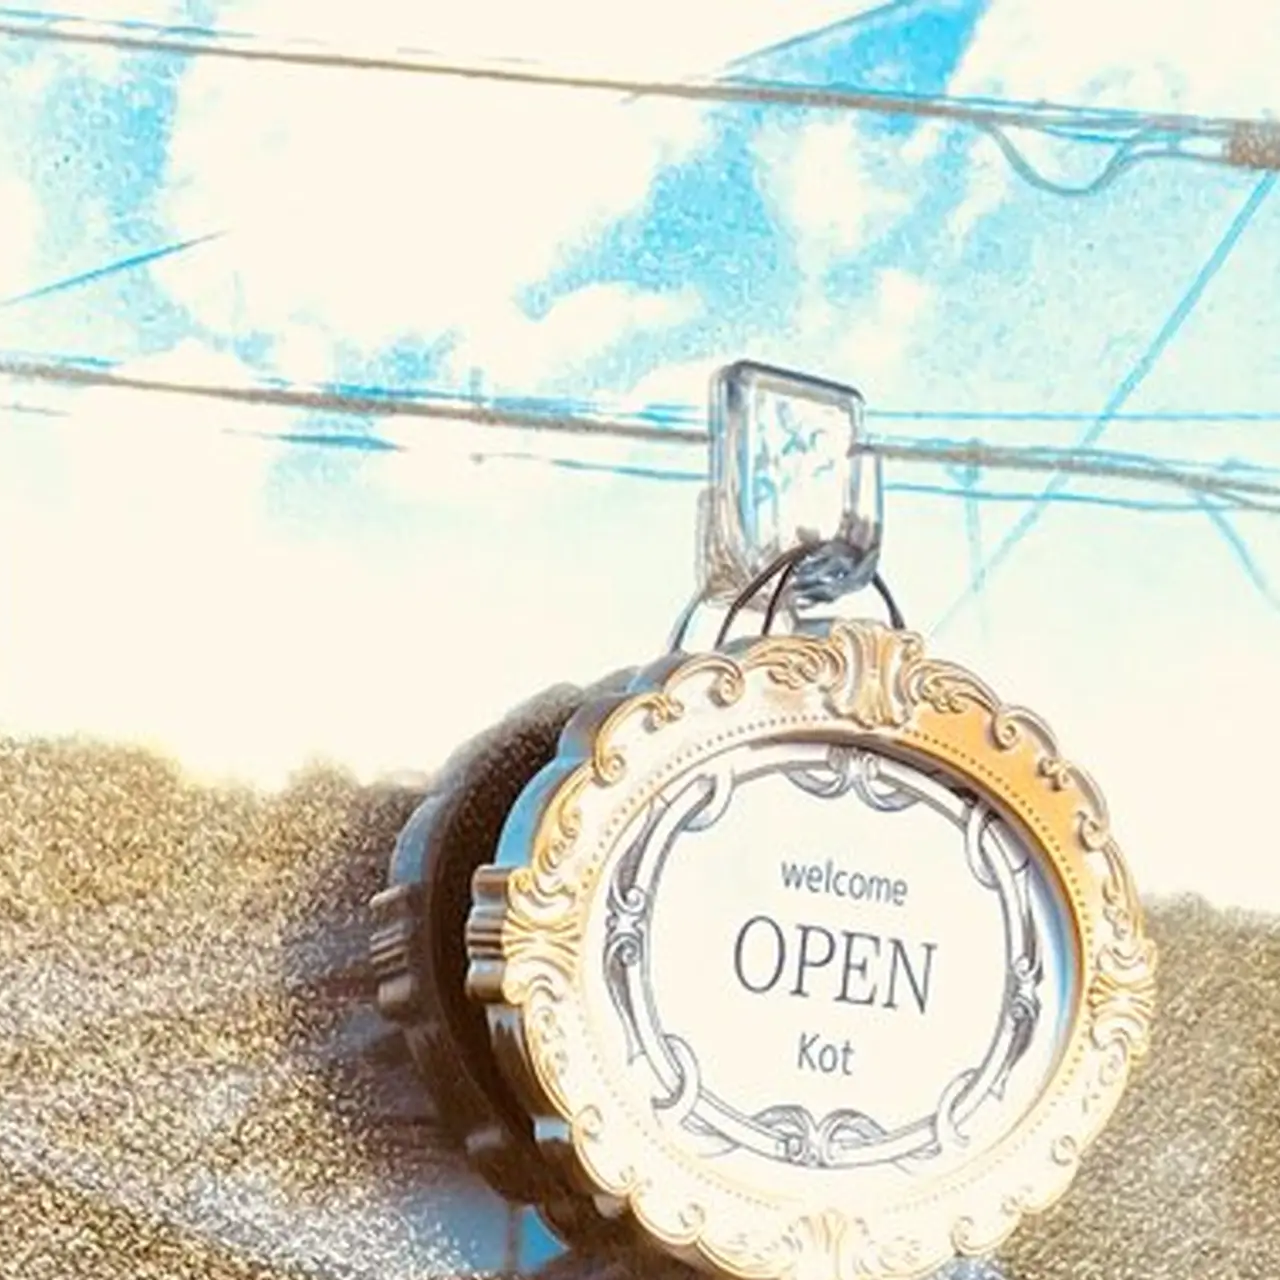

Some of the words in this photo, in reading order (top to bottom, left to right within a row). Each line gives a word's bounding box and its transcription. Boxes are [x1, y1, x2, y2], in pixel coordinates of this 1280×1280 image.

[781, 859, 908, 906] welcome
[733, 914, 938, 1014] OPEN
[797, 1031, 854, 1076] Kot
